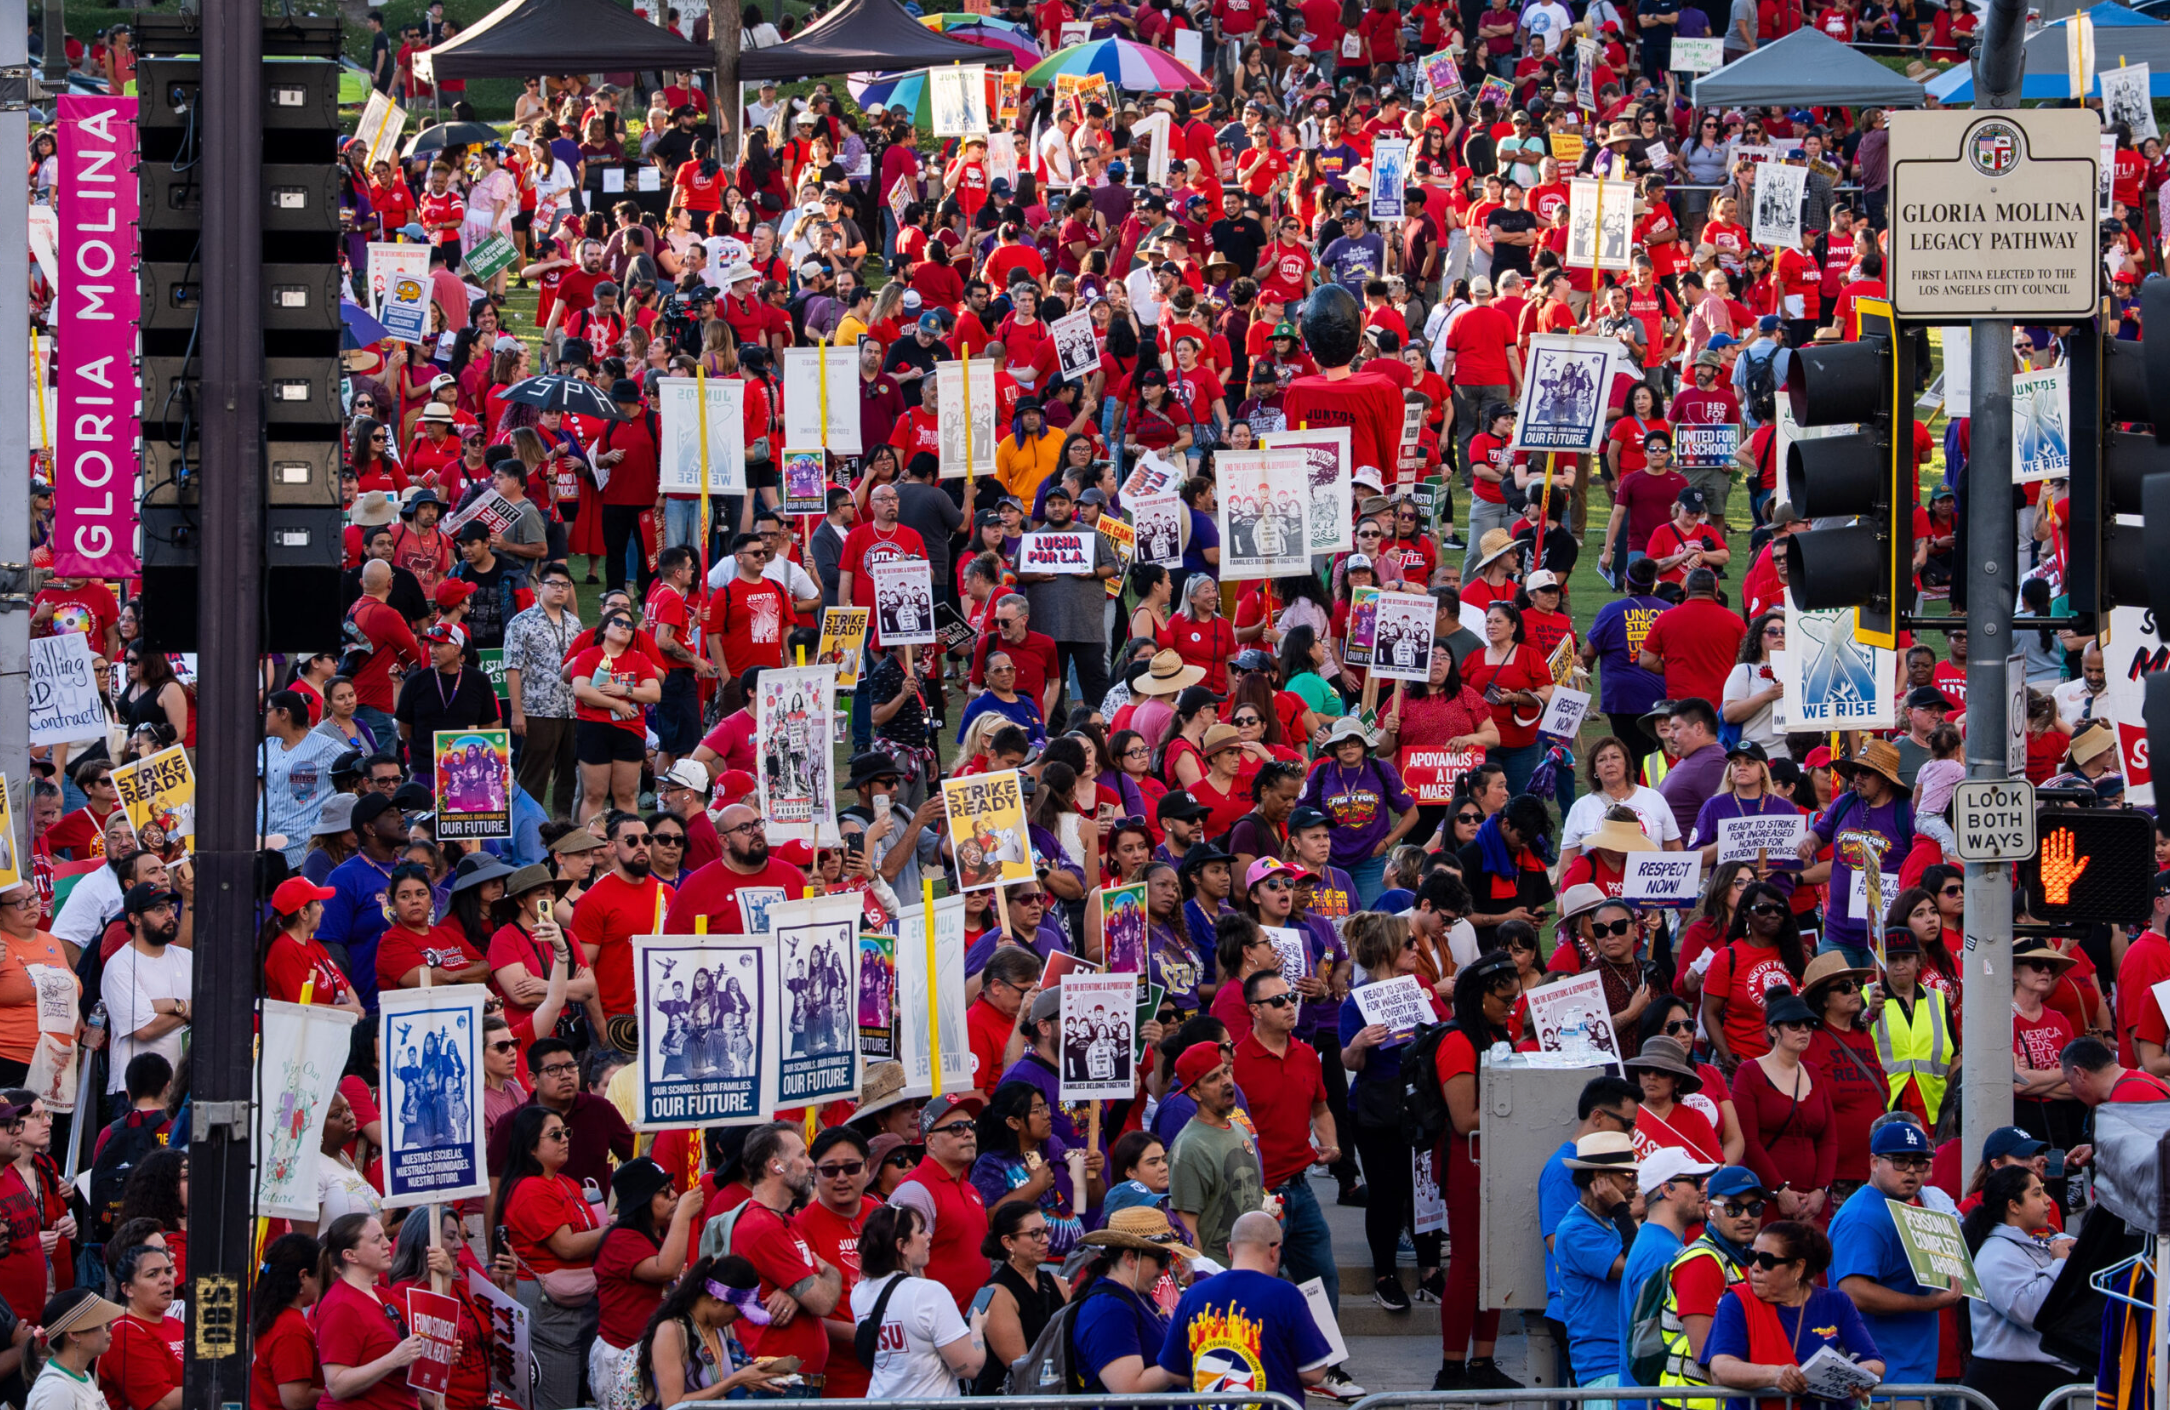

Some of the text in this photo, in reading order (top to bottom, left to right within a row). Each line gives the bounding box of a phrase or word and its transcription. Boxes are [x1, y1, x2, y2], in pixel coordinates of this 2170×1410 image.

[1902, 203, 2085, 223] GLORIA MOLINA
[1910, 232, 2078, 254] LEGACY PATHWAY
[1282, 263, 1302, 275] UTLA
[1912, 269, 2077, 281] FIRST LATINA ELECTED TO THE
[1918, 285, 2070, 296] LOS ANGELES CITY COUNCIL
[74, 108, 117, 559] GLORIA MOLINA
[1707, 402, 1727, 411] RED
[1707, 410, 1726, 419] FOR
[1306, 408, 1355, 424] JUNTOS
[1525, 432, 1588, 446] OUR FUTURE.
[1679, 430, 1737, 443] UNITED FOR
[1679, 443, 1737, 456] LA SCHOOLS
[2022, 456, 2070, 474] WE RISE
[491, 498, 520, 525] VOTE
[787, 501, 800, 510] OUR
[1099, 519, 1112, 534] WE
[1033, 535, 1083, 551] LUCHA
[1027, 550, 1088, 566] POR L.A.
[1230, 558, 1254, 566] FAMILIES
[1276, 557, 1304, 565] TOGETHER
[747, 592, 777, 602] JUNTOS
[826, 614, 866, 625] STRIKE
[823, 624, 864, 636] READY
[752, 636, 764, 644] WE
[1347, 650, 1364, 661] OUR
[1555, 697, 1585, 717] RESPECT
[1803, 701, 1878, 720] WE RISE
[1409, 751, 1473, 768] APOYAMOS
[2011, 743, 2025, 769] BIKE
[116, 755, 192, 794] STRIKE
[1436, 769, 1445, 783] A
[123, 773, 192, 807] READY
[947, 779, 1017, 803] STRIKE
[951, 794, 1019, 818] READY
[1967, 791, 2023, 808] LOOK
[440, 821, 508, 835] OUR FUTURE.
[1727, 819, 1799, 832] READY TO STRIKE
[1967, 812, 2023, 829] BOTH
[1730, 829, 1796, 841] FOR INCREASED
[1738, 836, 1785, 849] HOURS FOR
[1842, 833, 1887, 849] FIGHT FOR
[1966, 833, 2024, 849] WAYS
[1723, 846, 1759, 861] STUDENT
[1638, 861, 1693, 878] RESPECT
[1646, 878, 1682, 894] NOW!
[1749, 960, 1772, 984] ASCOT
[1064, 983, 1072, 992] END
[1073, 983, 1081, 991] THE
[1363, 981, 1416, 1002] READY TO STRIKE
[1366, 991, 1423, 1012] FOR WAGES ABOVE
[1381, 1001, 1419, 1020] POVERTY FOR
[1399, 1011, 1425, 1026] FAMILIES!
[783, 1055, 851, 1074] OUR SCHOOLS. OUR FAMILIES.
[652, 1080, 753, 1096] OUR SCHOOLS. OUR FAMILIES.
[783, 1066, 850, 1096] OUR FUTURE.
[1063, 1080, 1131, 1091] FAMILIES BELONG TOGETHER
[651, 1092, 753, 1119] OUR FUTURE.
[1905, 1127, 1918, 1145] LA
[401, 1147, 464, 1166] NUESTRAS ESCUELAS.
[395, 1156, 471, 1178] NUESTRAS COMUNIDADES.
[407, 1171, 460, 1188] NUESTRO FUTURO.
[1910, 1229, 1965, 1261] COMPLETO
[414, 1312, 456, 1342] FUND STUDENT
[1208, 1340, 1261, 1371] YEARS OF UNION
